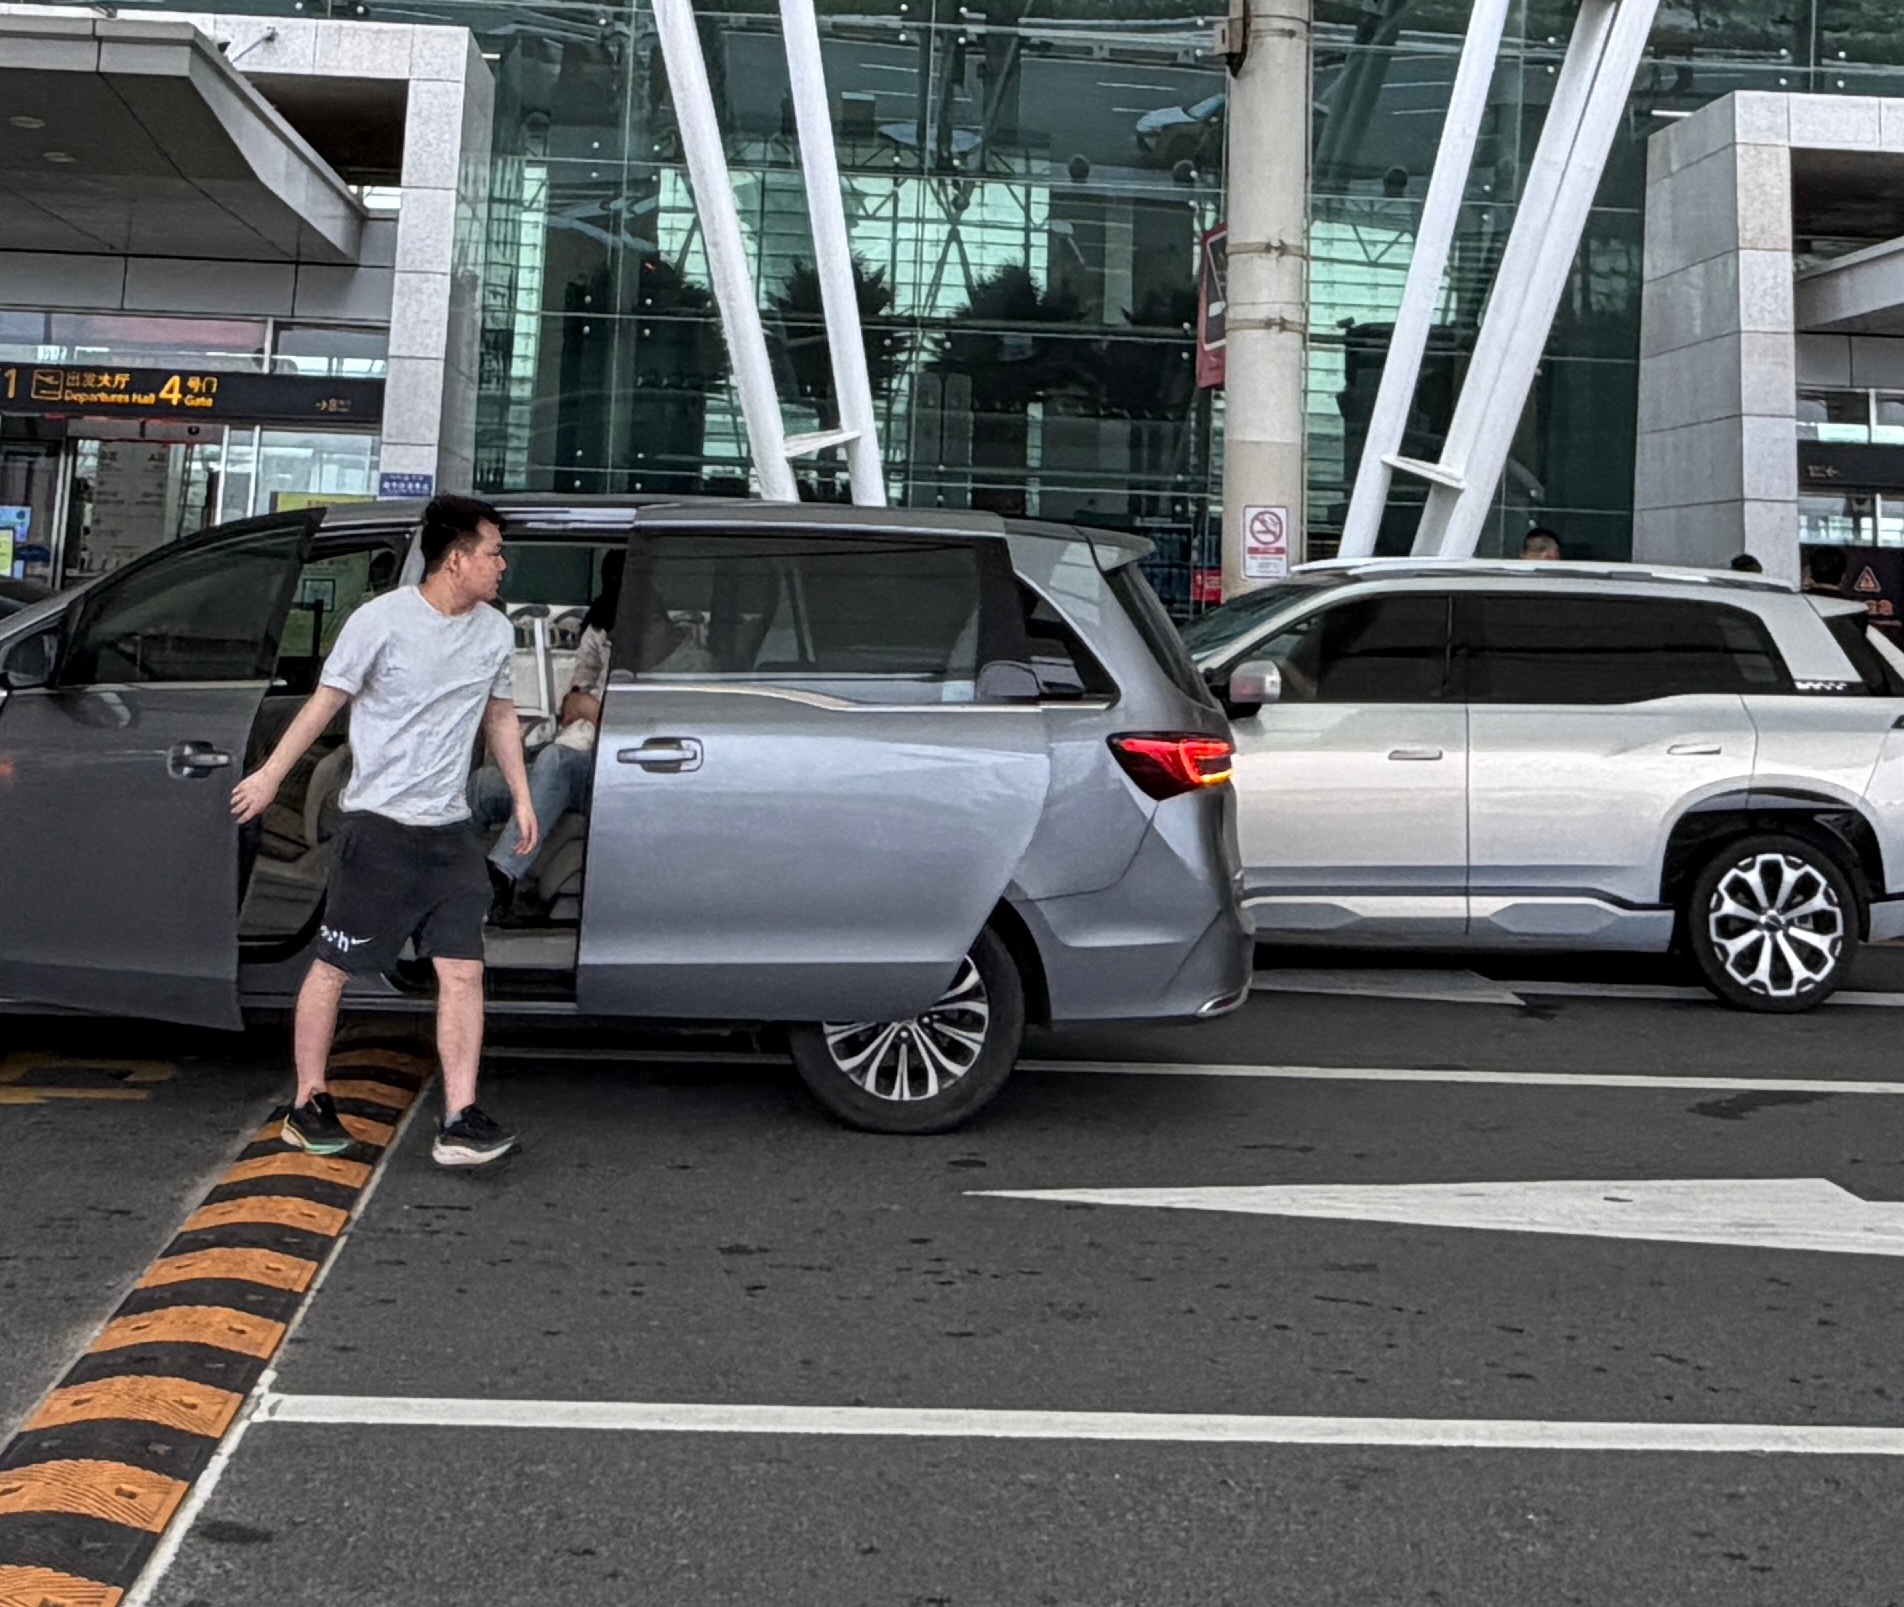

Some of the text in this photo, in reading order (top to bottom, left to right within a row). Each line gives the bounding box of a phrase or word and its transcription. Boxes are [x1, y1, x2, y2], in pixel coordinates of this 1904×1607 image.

[65, 371, 131, 390] 出发大厅
[186, 376, 218, 394] 号门
[64, 390, 156, 406] Departures Hall
[158, 375, 183, 406] 4
[184, 394, 214, 408] Gate
